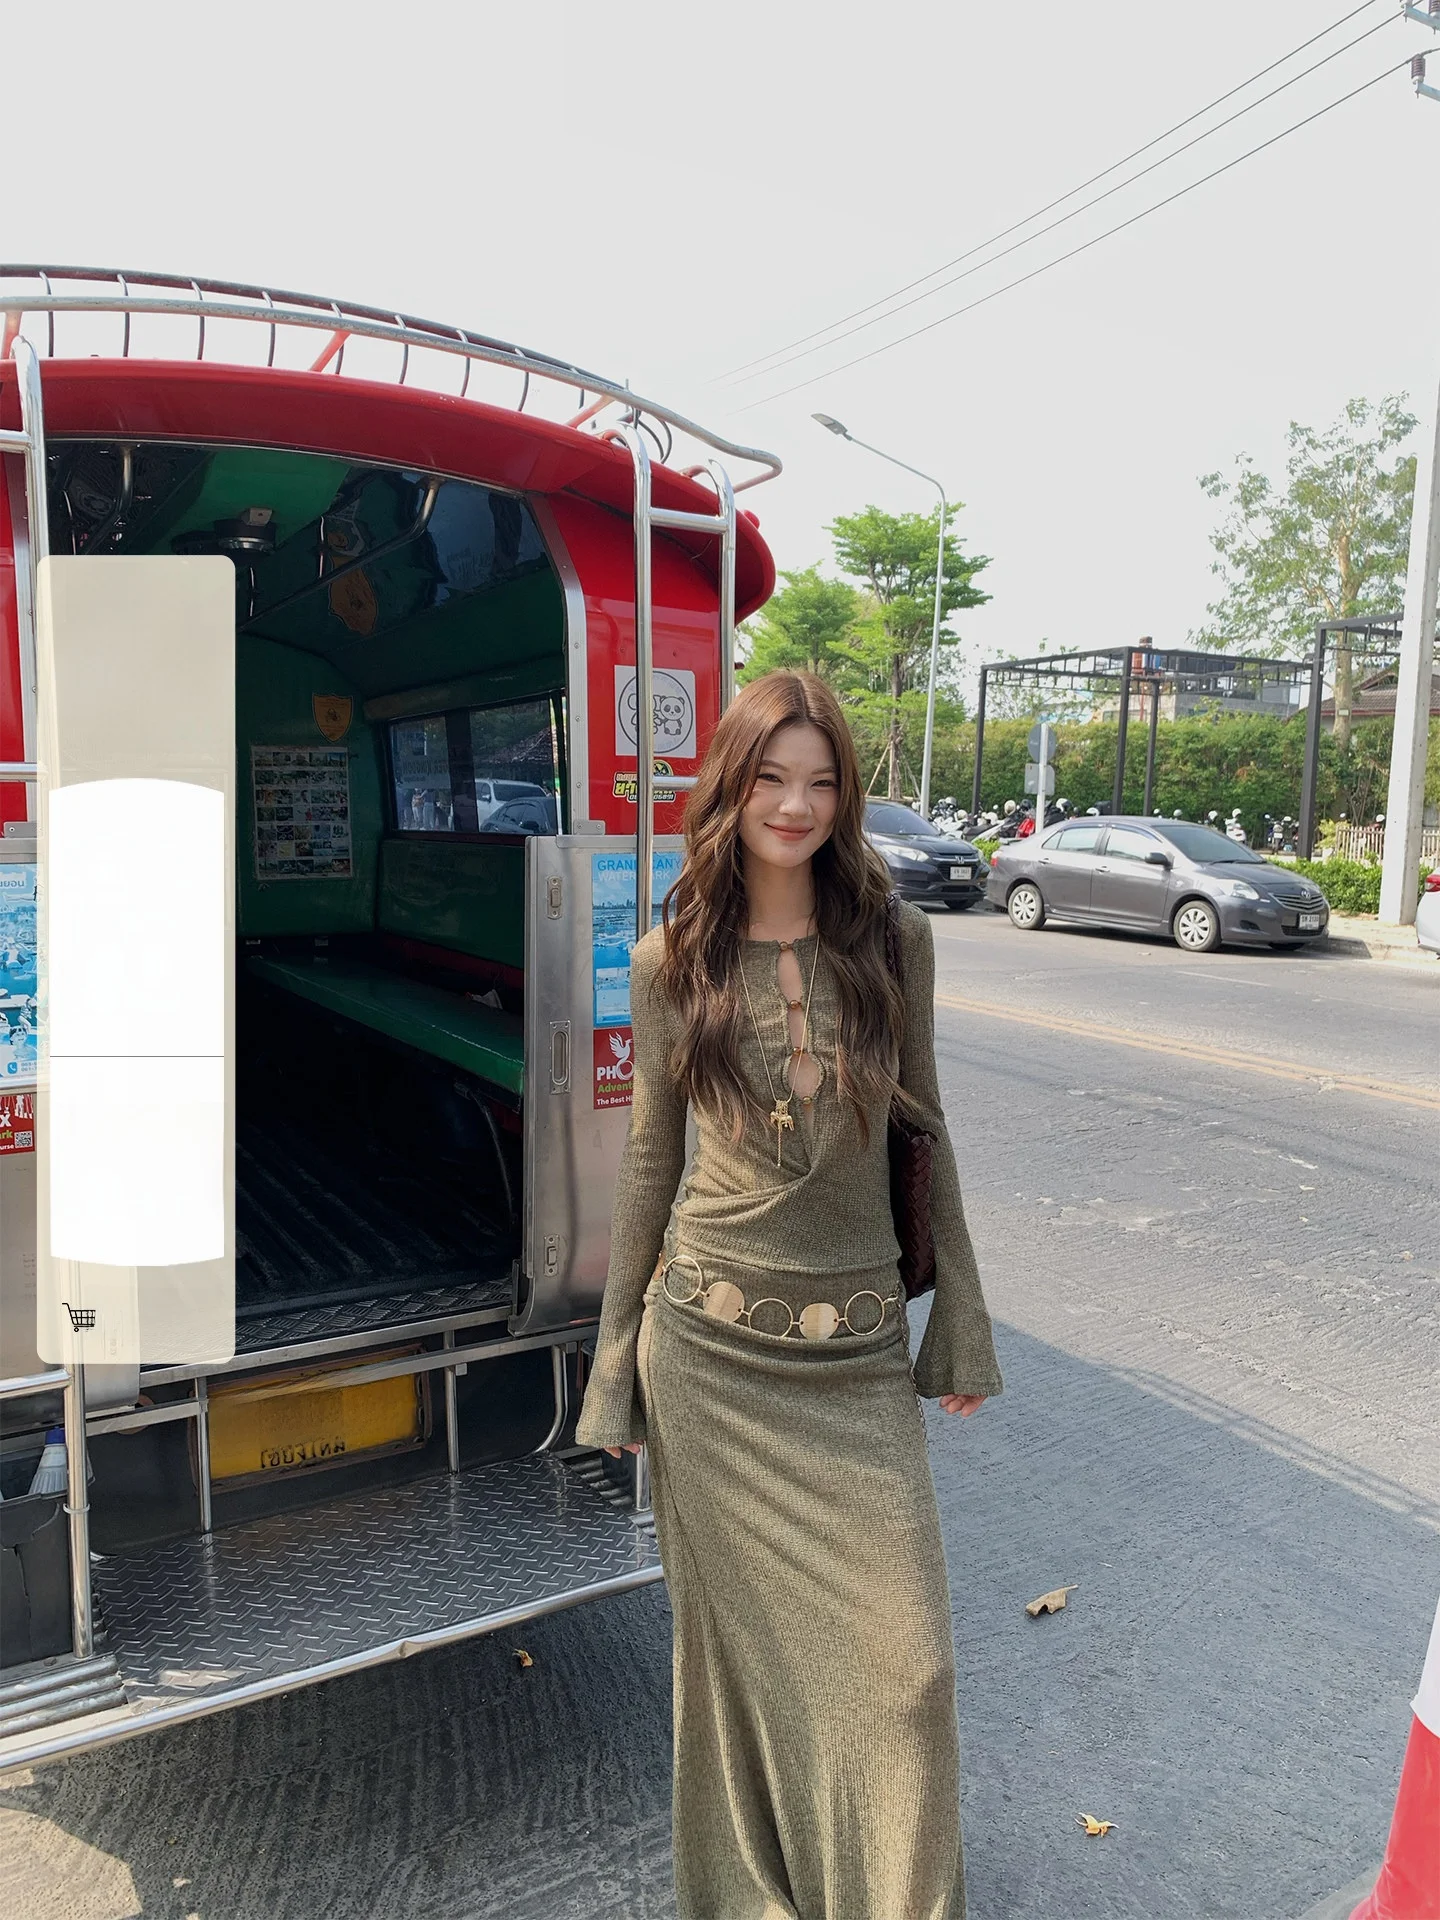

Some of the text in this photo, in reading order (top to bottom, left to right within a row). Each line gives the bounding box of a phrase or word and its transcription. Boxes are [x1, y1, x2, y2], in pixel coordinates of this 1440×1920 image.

[653, 857, 682, 869] ANY
[597, 1061, 634, 1081] PHO
[597, 1081, 633, 1094] Advent
[597, 1098, 609, 1106] The
[610, 1096, 625, 1104] Best
